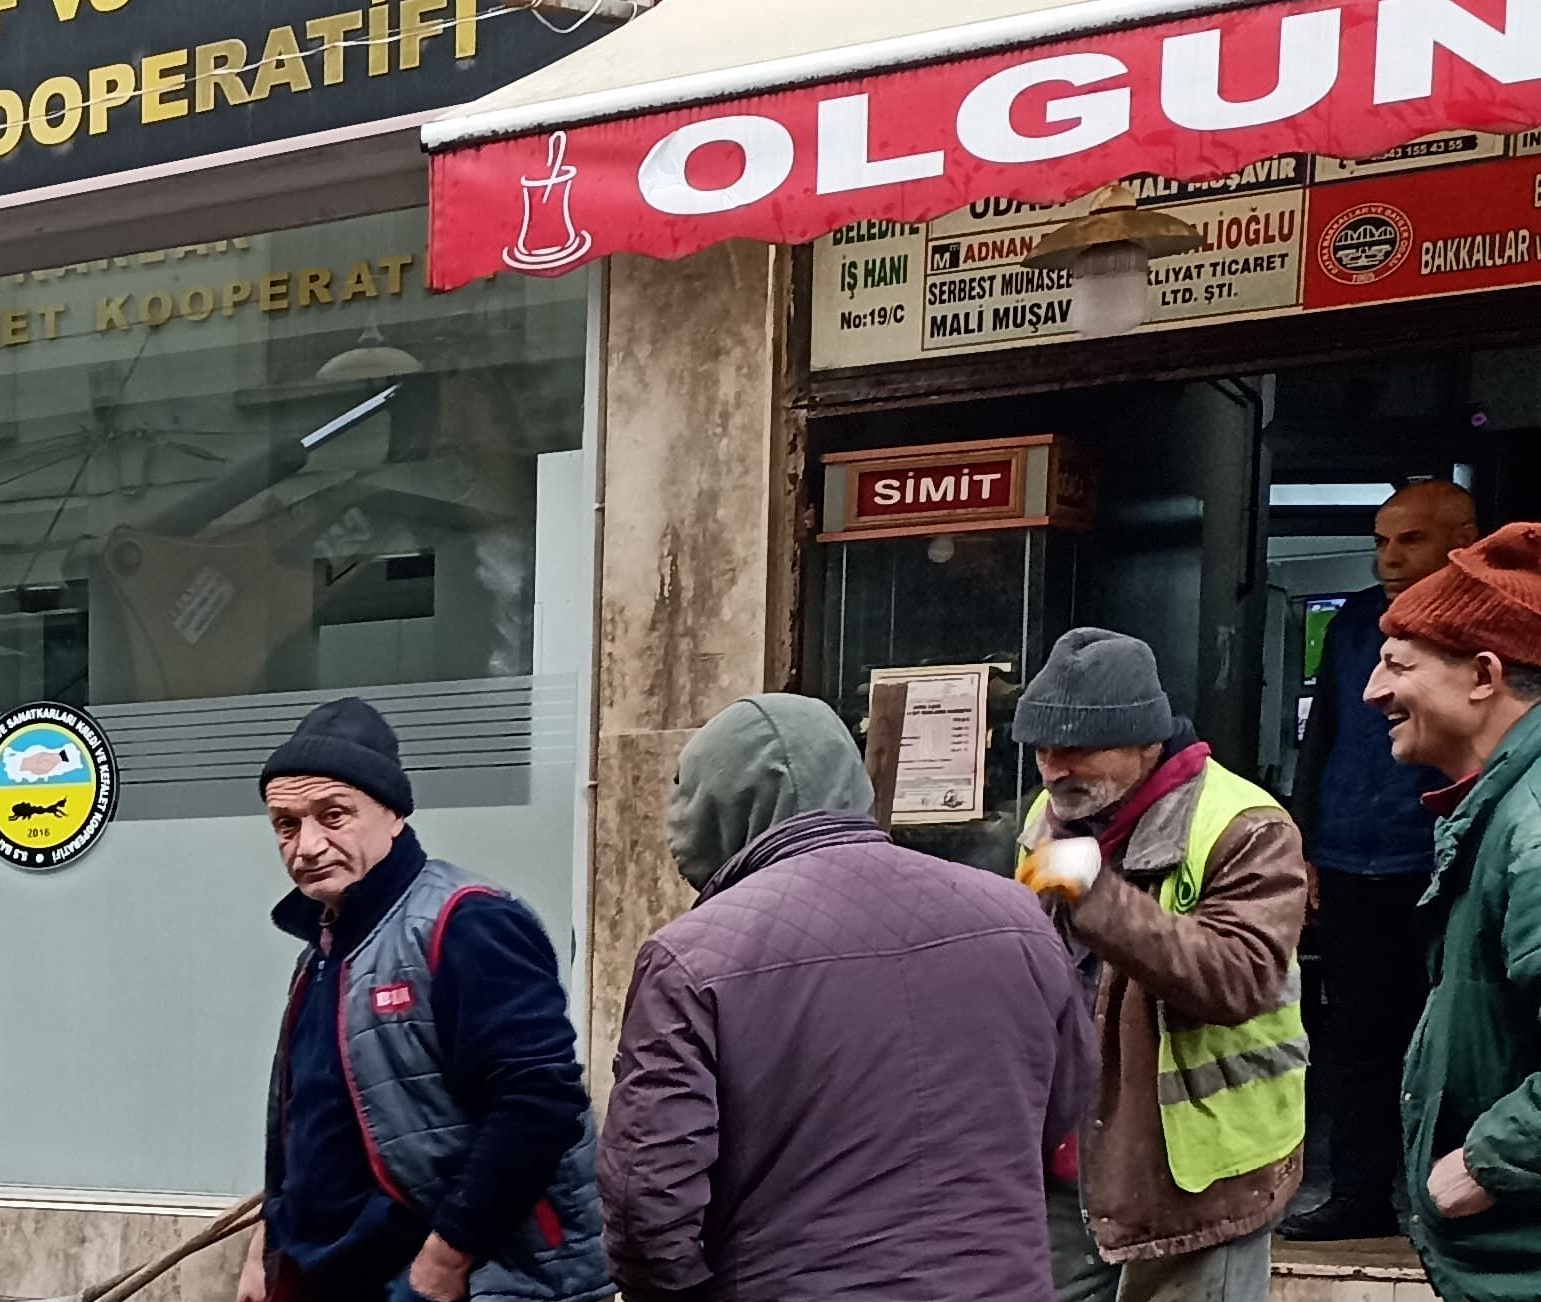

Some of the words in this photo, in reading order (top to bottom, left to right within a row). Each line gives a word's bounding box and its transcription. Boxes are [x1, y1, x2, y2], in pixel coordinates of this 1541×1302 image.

[637, 0, 1541, 217] OLGUN
[962, 235, 1033, 265] ADNAN
[1420, 228, 1530, 275] BAKKALLAR
[95, 255, 432, 333] KOOPERAT
[840, 254, 858, 299] İŞ
[863, 254, 909, 289] HANI
[927, 274, 997, 306] SERBEST
[1161, 287, 1198, 306] LTD.
[839, 304, 905, 330] No:19/C
[929, 303, 984, 338] MALİ
[872, 467, 1002, 506] SİMİT
